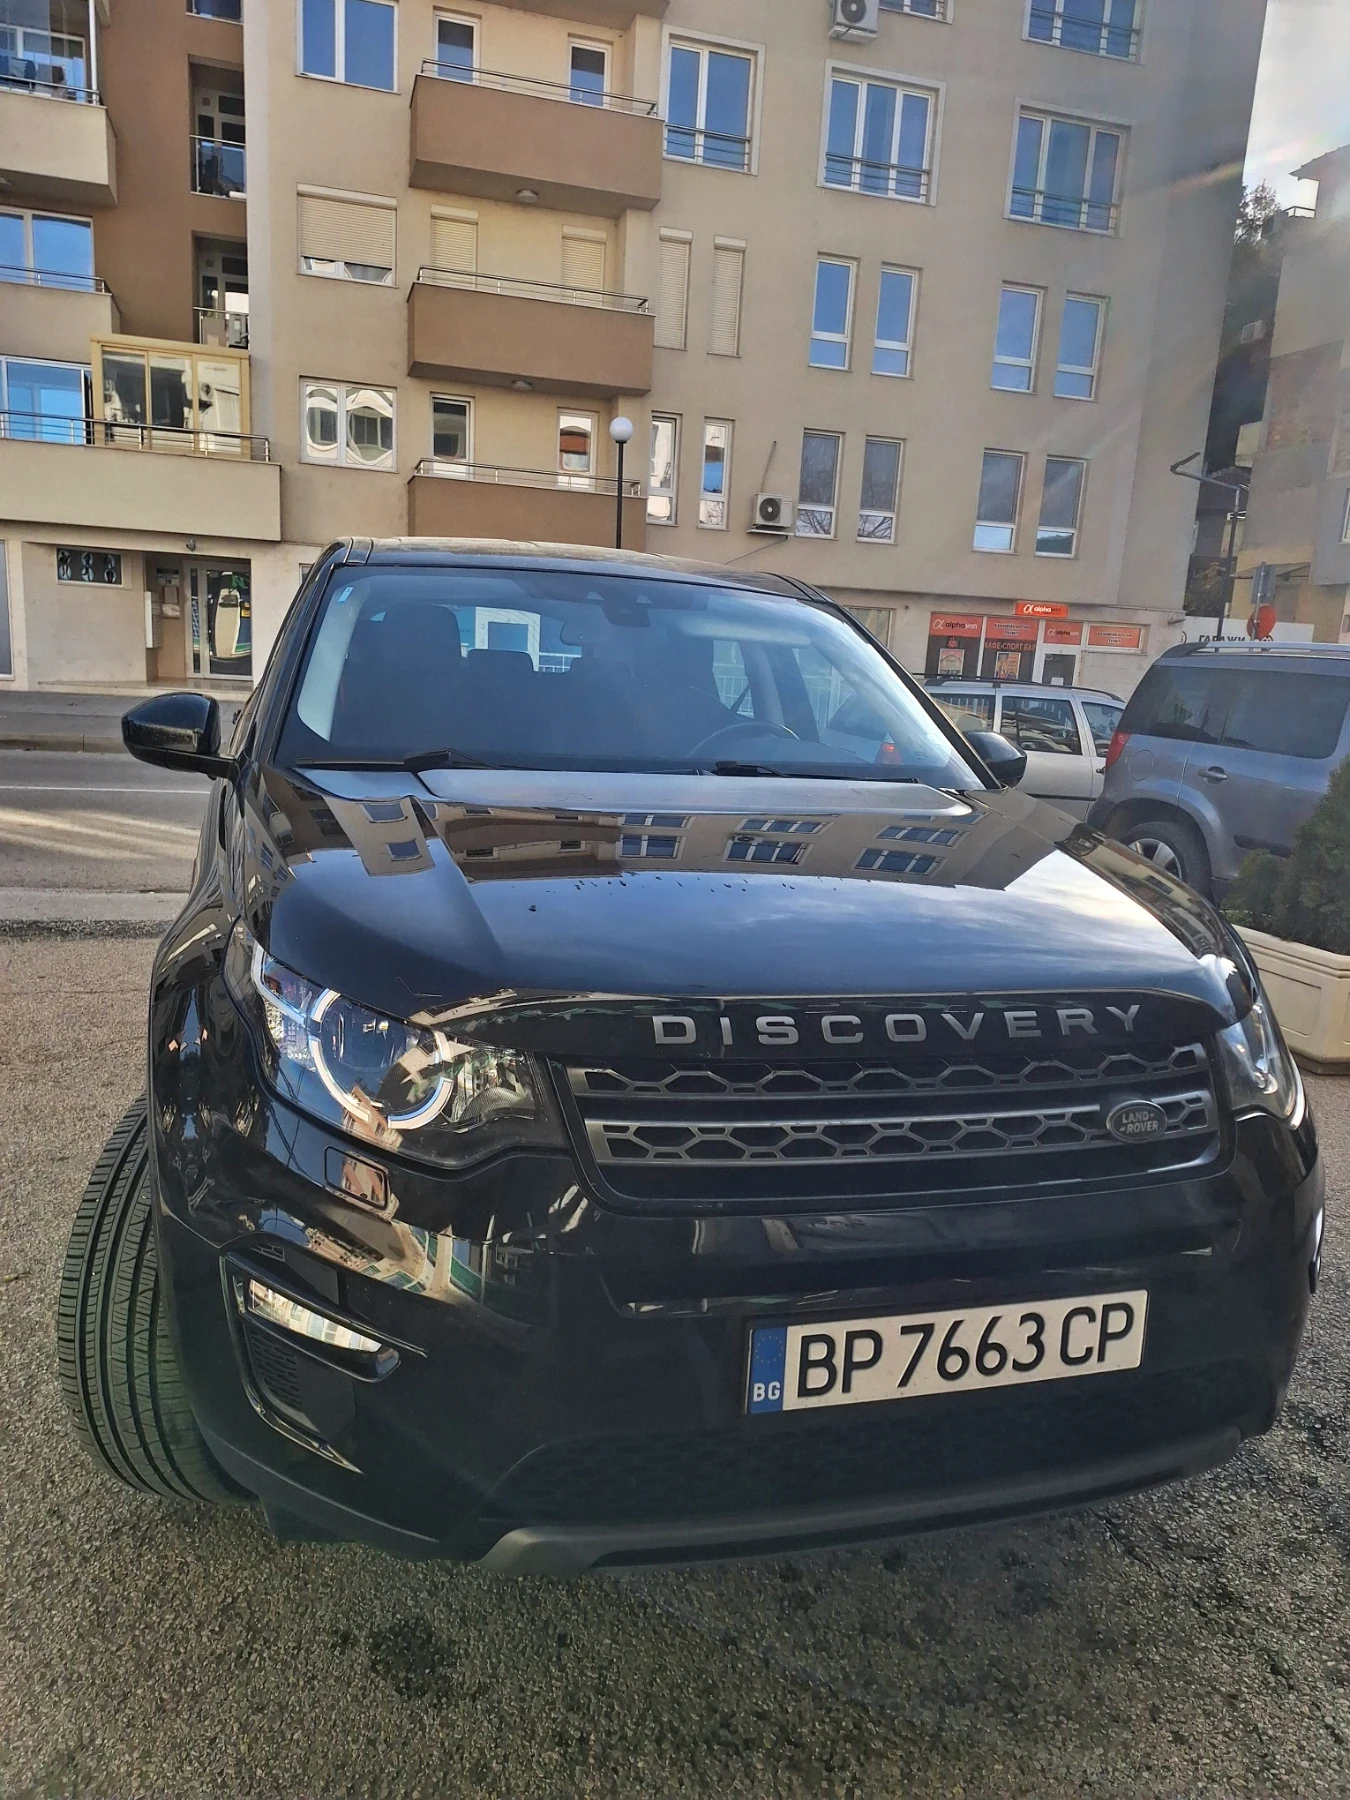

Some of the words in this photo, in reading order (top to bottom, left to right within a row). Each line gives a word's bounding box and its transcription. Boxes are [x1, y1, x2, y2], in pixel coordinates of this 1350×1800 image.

[945, 620, 978, 630] alphawin
[652, 1004, 1142, 1046] DISCOVERY
[896, 1311, 1046, 1389] 7663
[752, 1380, 782, 1403] BG
